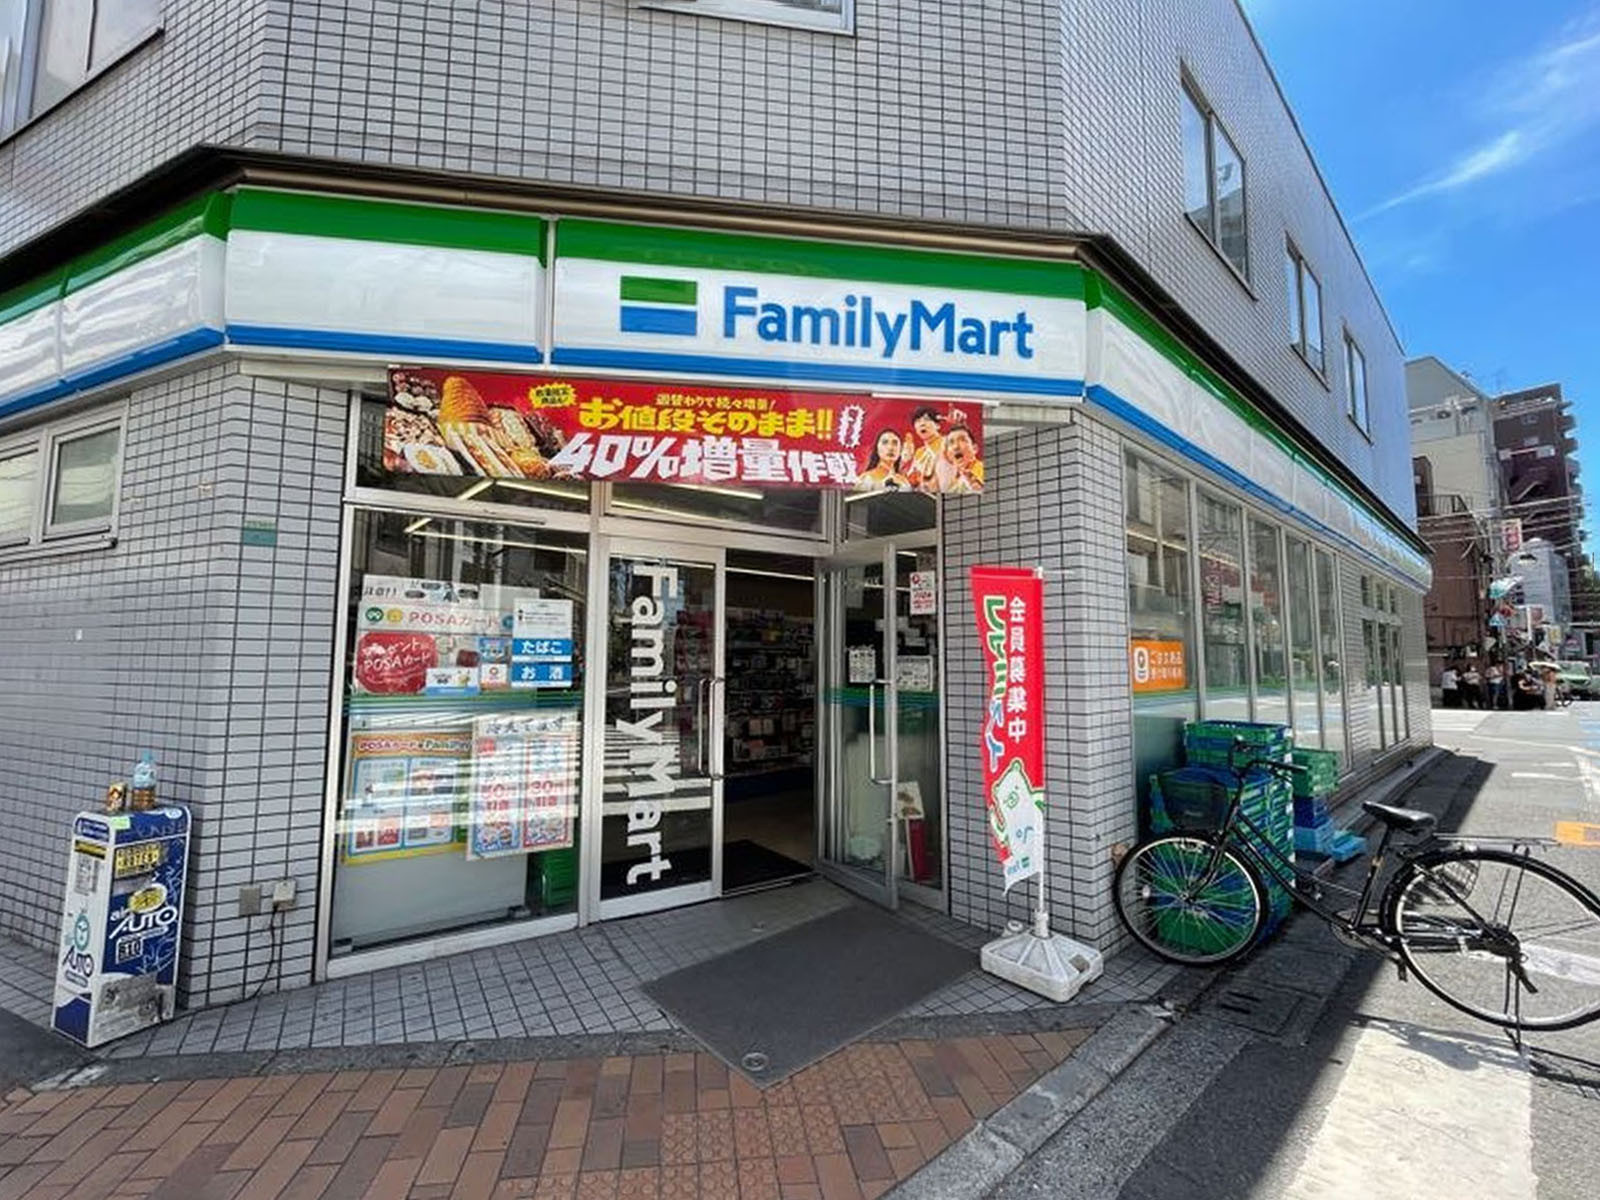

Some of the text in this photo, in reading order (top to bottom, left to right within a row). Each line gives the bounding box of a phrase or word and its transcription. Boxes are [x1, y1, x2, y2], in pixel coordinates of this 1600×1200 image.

[723, 285, 1034, 359] FamilyMart
[578, 397, 834, 440] お値段そのまま!!
[549, 431, 860, 484] 40%増量作戦
[521, 640, 563, 655] たばこ
[1007, 596, 1027, 744] 会員募集中
[615, 563, 678, 885] FamilyMart
[108, 905, 179, 940] AUTO
